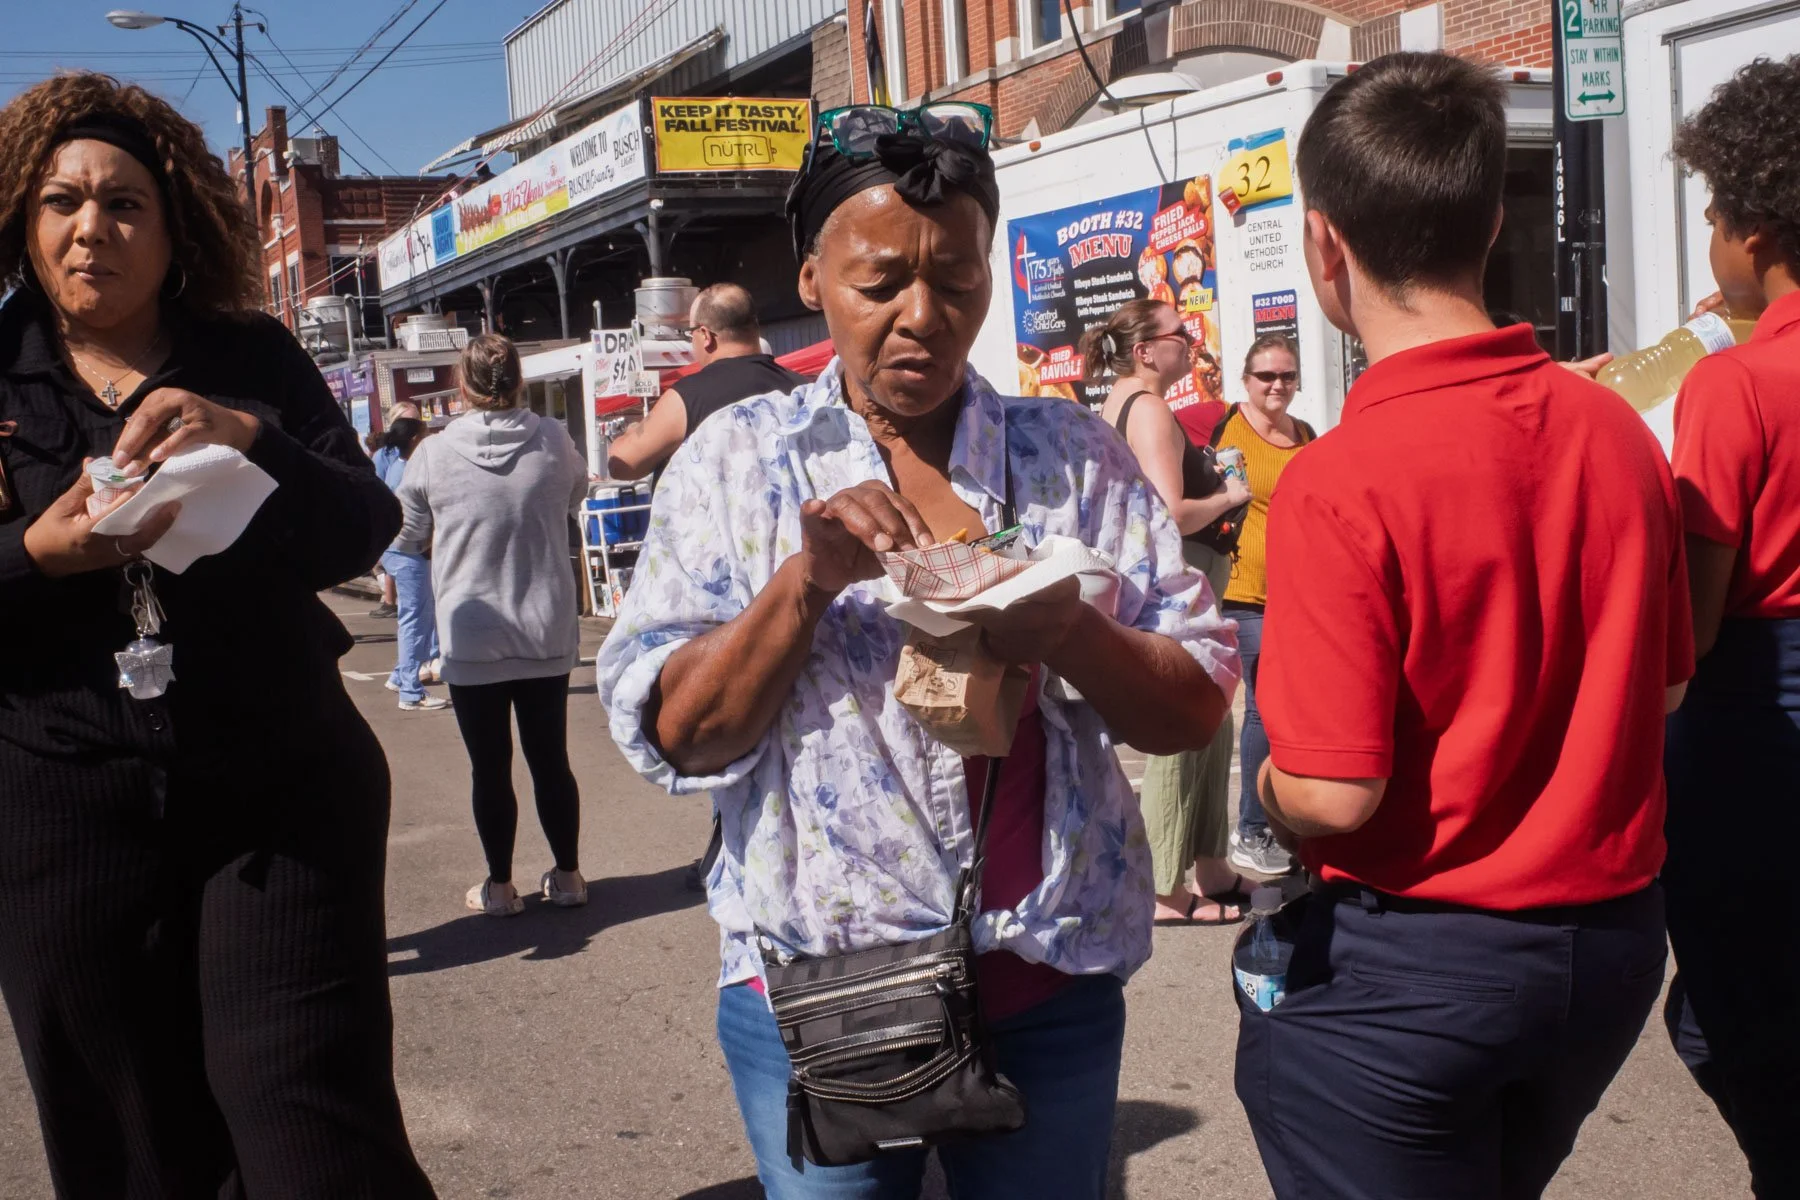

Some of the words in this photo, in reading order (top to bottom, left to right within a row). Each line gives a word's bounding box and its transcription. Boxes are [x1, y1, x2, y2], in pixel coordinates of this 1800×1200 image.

[1593, 0, 1608, 14] HR
[1565, 0, 1580, 32] 2
[1583, 17, 1619, 34] PARKING
[1570, 48, 1588, 65] STAY
[1593, 47, 1619, 63] WITHIN
[1581, 70, 1611, 88] MARKS
[660, 104, 712, 118] KEEP
[715, 104, 732, 118] IT
[736, 104, 802, 120] TASTY,
[664, 119, 712, 133] FALL
[714, 119, 805, 134] FESTIVAL.
[569, 134, 598, 169] WELCOME
[598, 131, 608, 155] TO
[613, 129, 640, 161] BUSCH
[620, 153, 636, 168] LIGHT
[1238, 155, 1272, 198] 32
[1154, 205, 1184, 231] FRIED
[1247, 219, 1283, 233] CENTRAL
[1056, 211, 1113, 246] BOOTH
[1115, 210, 1144, 230] #32
[1151, 223, 1177, 243] PEPPER
[1178, 213, 1195, 230] JACK
[1155, 230, 1182, 250] CHEESE
[1183, 219, 1205, 238] BALLS
[1249, 232, 1282, 246] UNITED
[1068, 233, 1132, 269] MENU
[1244, 244, 1288, 259] METHODIST
[1028, 258, 1047, 280] 175
[1250, 258, 1284, 272] CHURCH
[1106, 270, 1133, 284] Sandwich
[1108, 288, 1135, 302] Sandwich
[1189, 294, 1209, 306] NEW!
[1271, 294, 1295, 306] FOOD
[1255, 304, 1296, 323] MENU
[1050, 349, 1071, 364] FRIED
